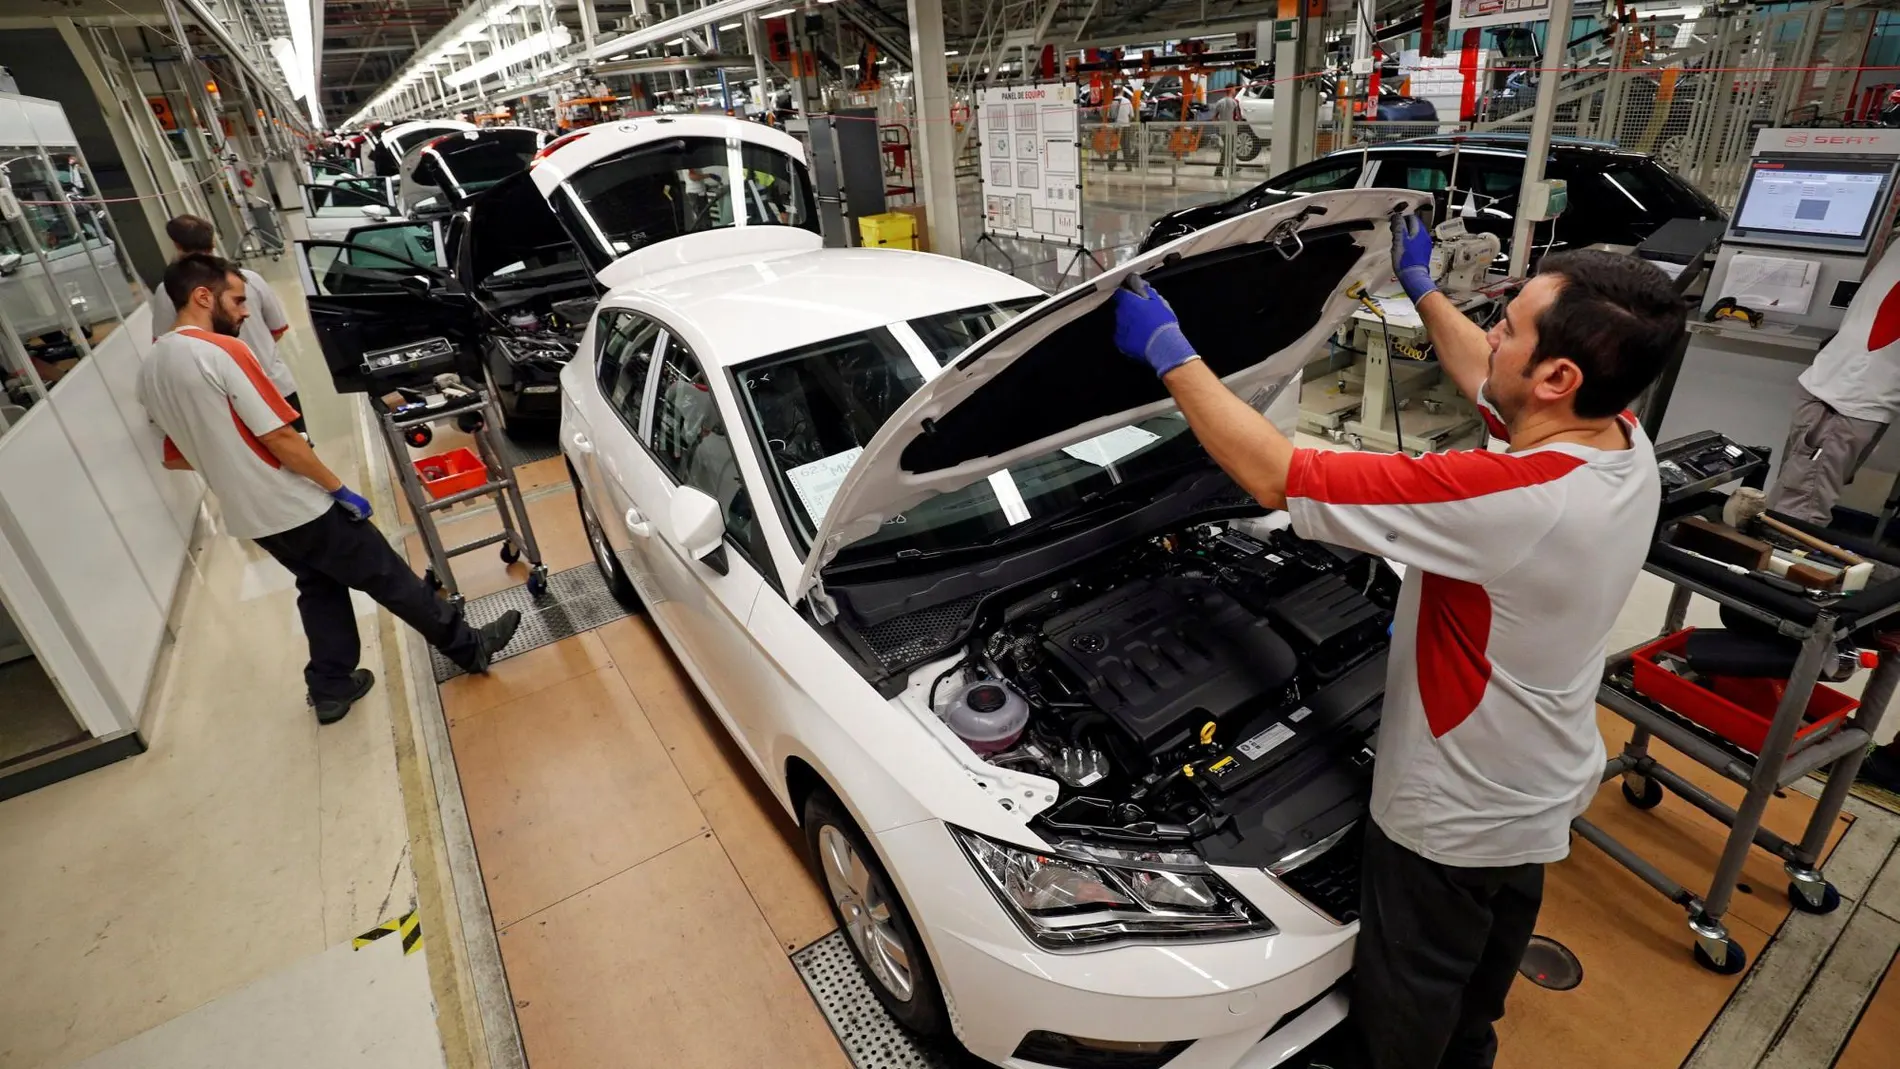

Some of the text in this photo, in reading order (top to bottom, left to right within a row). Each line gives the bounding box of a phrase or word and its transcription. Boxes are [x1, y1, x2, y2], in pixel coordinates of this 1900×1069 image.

[1001, 90, 1046, 100] PANEL DE EQUIPO
[1813, 136, 1880, 145] SEAT
